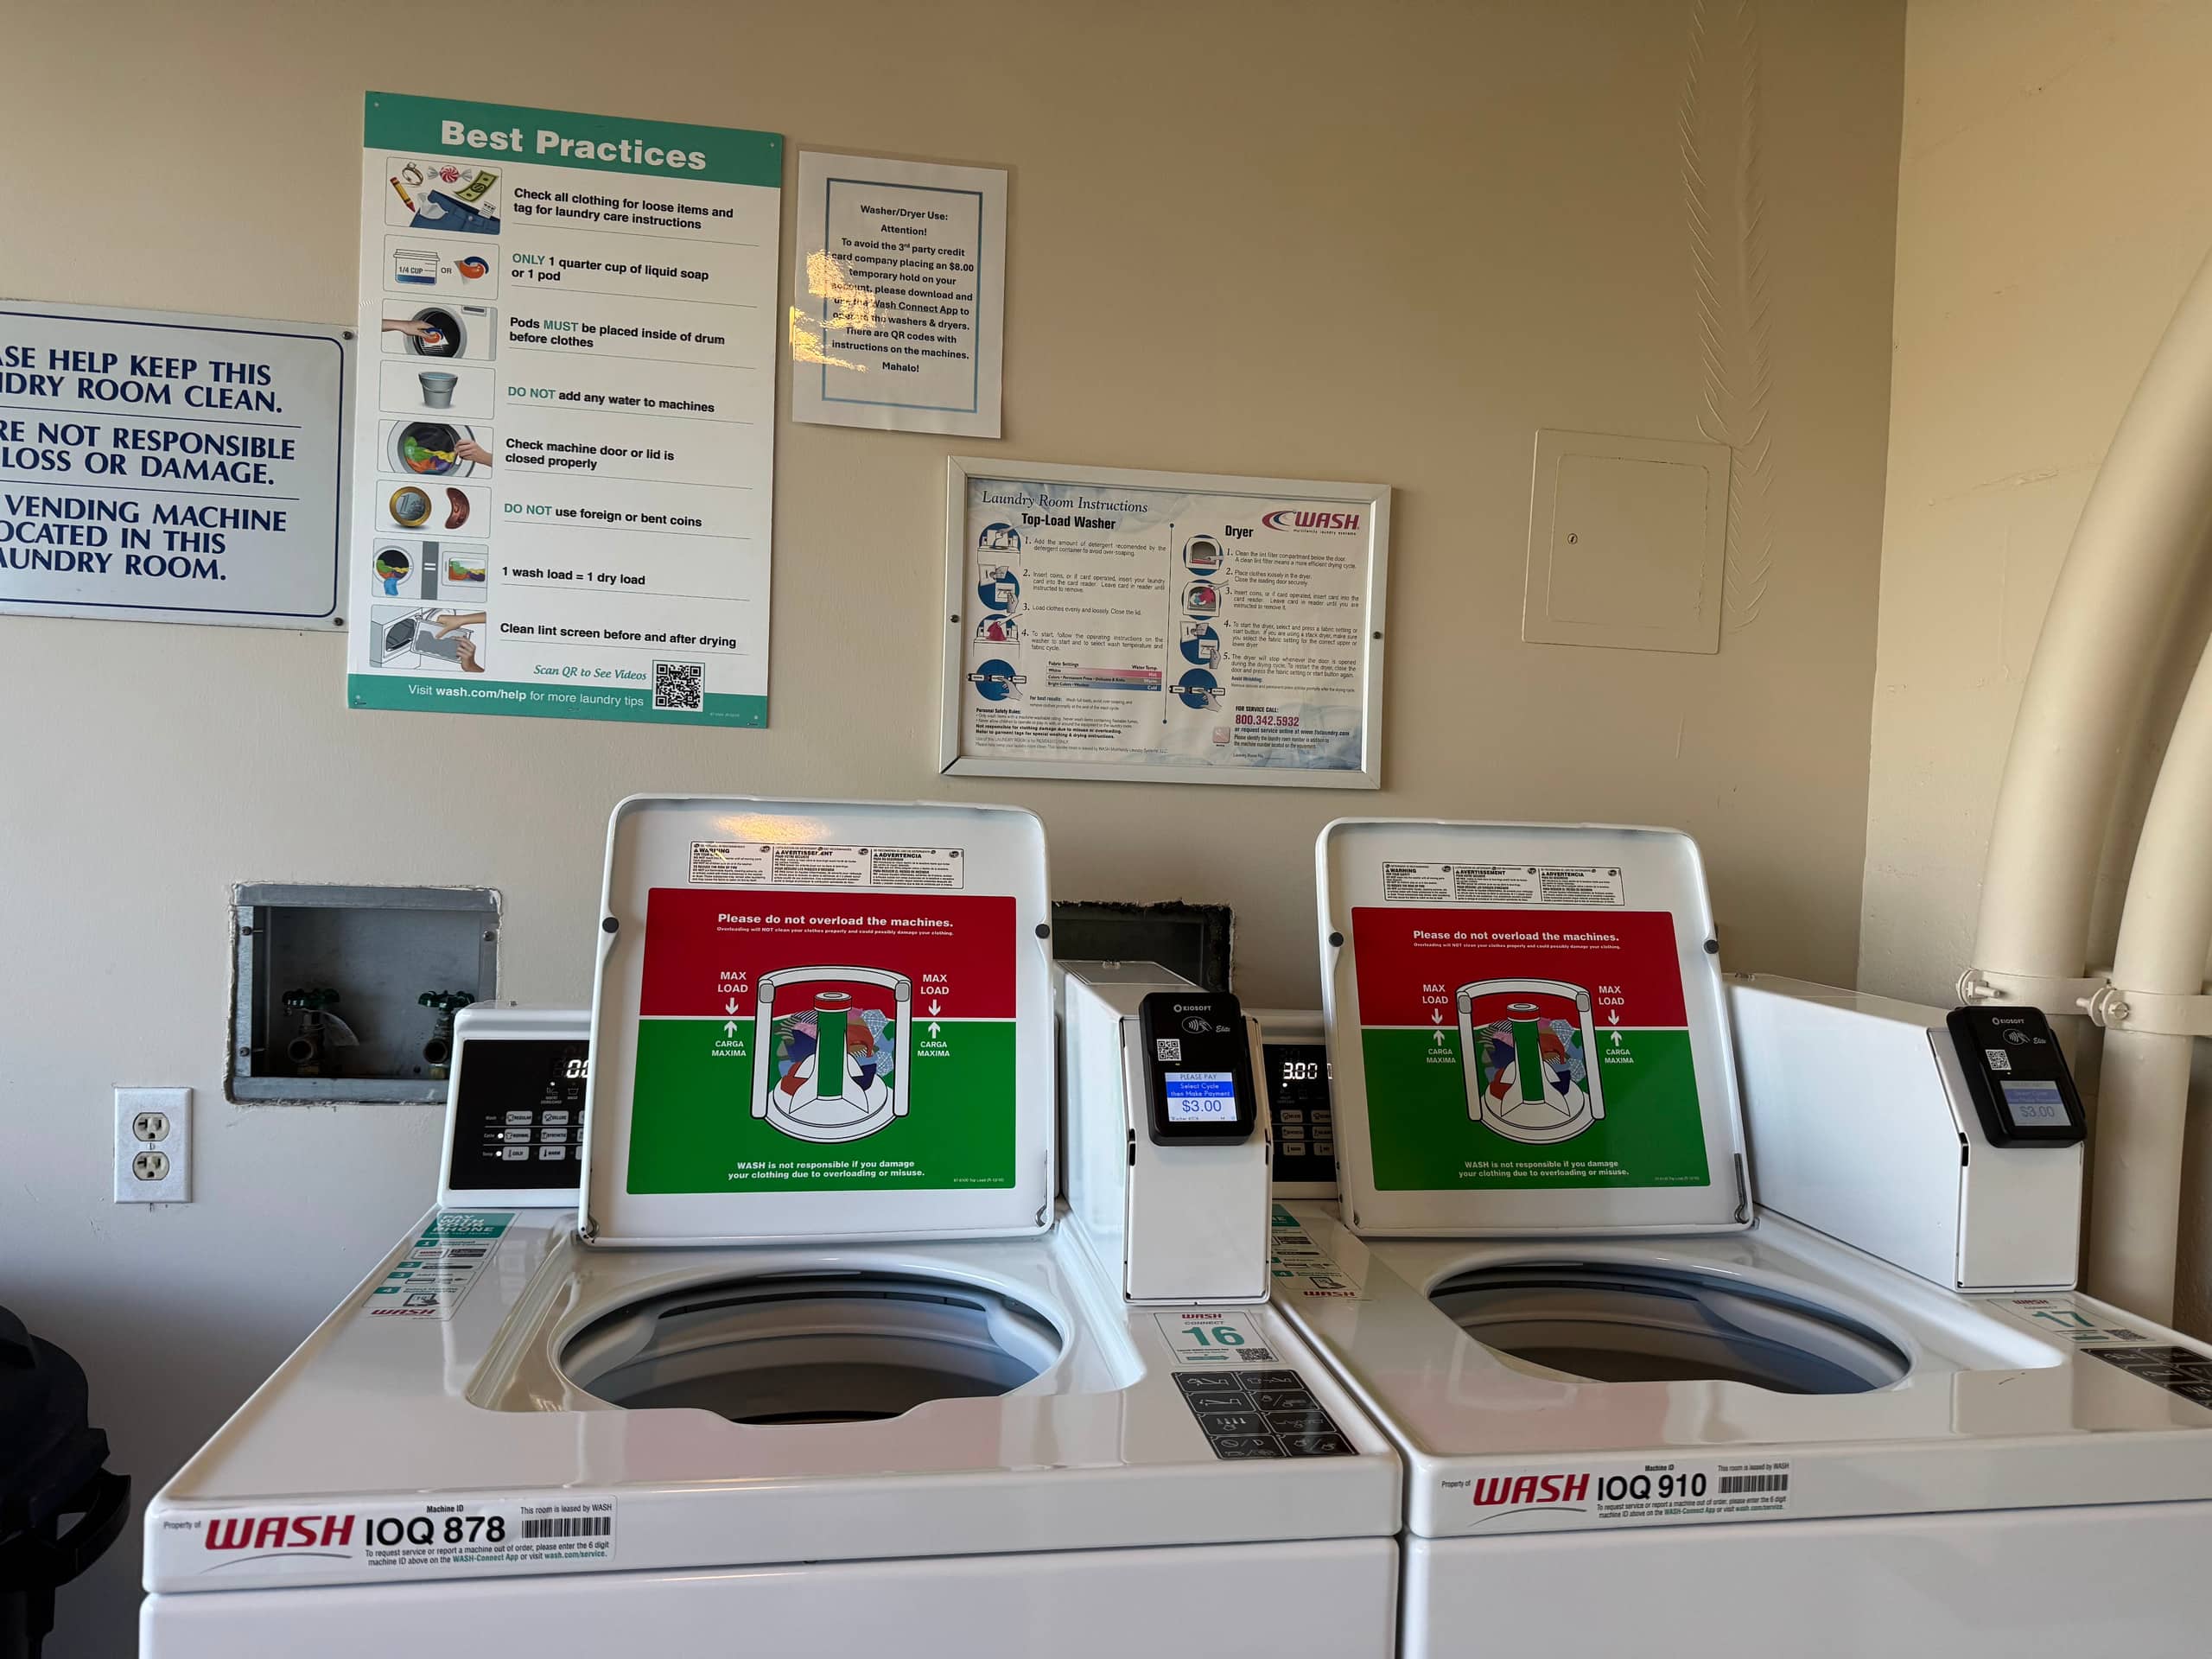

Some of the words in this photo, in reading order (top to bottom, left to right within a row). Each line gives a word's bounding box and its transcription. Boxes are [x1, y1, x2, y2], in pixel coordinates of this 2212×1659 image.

[442, 120, 524, 152] Best
[537, 130, 706, 170] Practices
[514, 188, 551, 200] Check
[555, 192, 569, 202] all
[572, 194, 620, 210] clothing
[622, 198, 639, 209] for
[642, 200, 674, 213] loose
[677, 203, 709, 216] items
[712, 208, 734, 218] and
[513, 203, 532, 216] tag
[536, 204, 553, 215] for
[556, 206, 601, 222] laundry
[603, 213, 629, 223] care
[632, 213, 702, 229] instructions
[861, 205, 925, 219] Washer/Dryer
[927, 211, 948, 220] Use:
[880, 224, 927, 236] Attention!
[842, 238, 852, 246] To
[854, 240, 880, 249] avoid
[881, 242, 897, 251] the
[899, 243, 910, 251] 3rd
[912, 246, 936, 256] party
[938, 248, 965, 257] credit
[855, 255, 898, 267] company
[899, 258, 934, 270] placing
[949, 262, 974, 272] $8.00
[832, 340, 888, 353] instructions
[904, 346, 919, 355] the
[921, 349, 969, 359] machines.
[0, 346, 35, 369] SE
[49, 349, 118, 373] HELP
[130, 354, 197, 380] KEEP
[208, 360, 271, 386] THIS
[882, 361, 919, 372] Mahalo!
[0, 372, 65, 397] DRY
[78, 378, 171, 405] ROOM
[184, 385, 282, 413] CLEAN.
[508, 386, 526, 397] DO
[530, 388, 556, 399] NOT
[558, 391, 581, 401] add
[583, 394, 605, 405] any
[608, 396, 641, 406] water
[644, 397, 656, 408] to
[658, 400, 715, 413] machines
[38, 422, 101, 447] NOT
[113, 428, 296, 461] RESPONSIBLE
[2, 447, 71, 472] LOSS
[85, 452, 127, 475] OR
[141, 455, 274, 486] DAMAGE.
[982, 491, 1037, 509] Laundry
[1036, 493, 1074, 510] Room
[1077, 496, 1147, 513] Instructions
[4, 494, 139, 524] VENDING
[152, 504, 287, 532] MACHINE
[1021, 512, 1071, 527] Top-Load
[1074, 516, 1116, 530] Washer
[1294, 511, 1357, 530] WASH
[121, 527, 150, 550] IN
[162, 530, 226, 555] THIS
[1225, 525, 1254, 540] Dryer
[125, 554, 226, 581] ROOM.
[533, 664, 559, 676] Scan
[562, 666, 578, 678] QR
[581, 668, 591, 677] to
[593, 668, 612, 678] See
[615, 669, 647, 681] Videos
[408, 684, 432, 696] Visit
[435, 687, 527, 702] wash.com/help
[530, 690, 545, 701] for
[548, 694, 576, 702] more
[580, 693, 621, 707] laundry
[624, 696, 644, 708] tips
[1236, 715, 1300, 727] 800.342.5932
[718, 913, 761, 923] Please
[765, 914, 781, 924] do
[785, 915, 805, 925] not
[809, 916, 863, 925] overload
[867, 916, 887, 926] the
[891, 918, 953, 927] machines.
[1414, 931, 1450, 939] Please
[1453, 931, 1467, 940] do
[1491, 931, 1539, 940] overload
[1541, 931, 1560, 940] the
[1563, 932, 1619, 941] machines.
[721, 971, 747, 980] MAX
[923, 974, 947, 982] MAX
[717, 984, 748, 993] LOAD
[920, 986, 950, 995] LOAD
[1283, 1063, 1318, 1080] 3.00
[1182, 1099, 1222, 1113] $3.00
[2019, 1106, 2055, 1118] $3.00
[751, 1171, 789, 1179] clothing
[823, 1169, 876, 1178] overloading
[797, 1160, 849, 1170] responsible
[2032, 1311, 2095, 1327] 17
[1182, 1326, 1244, 1346] 16
[1473, 1473, 1590, 1506] WASH
[1598, 1475, 1651, 1501] IOQ
[1658, 1472, 1707, 1498] 910
[520, 1506, 534, 1515] This
[582, 1504, 590, 1513] by
[163, 1521, 192, 1529] Property
[205, 1515, 355, 1550] WASH
[366, 1516, 434, 1546] IOQ
[443, 1516, 505, 1543] 878
